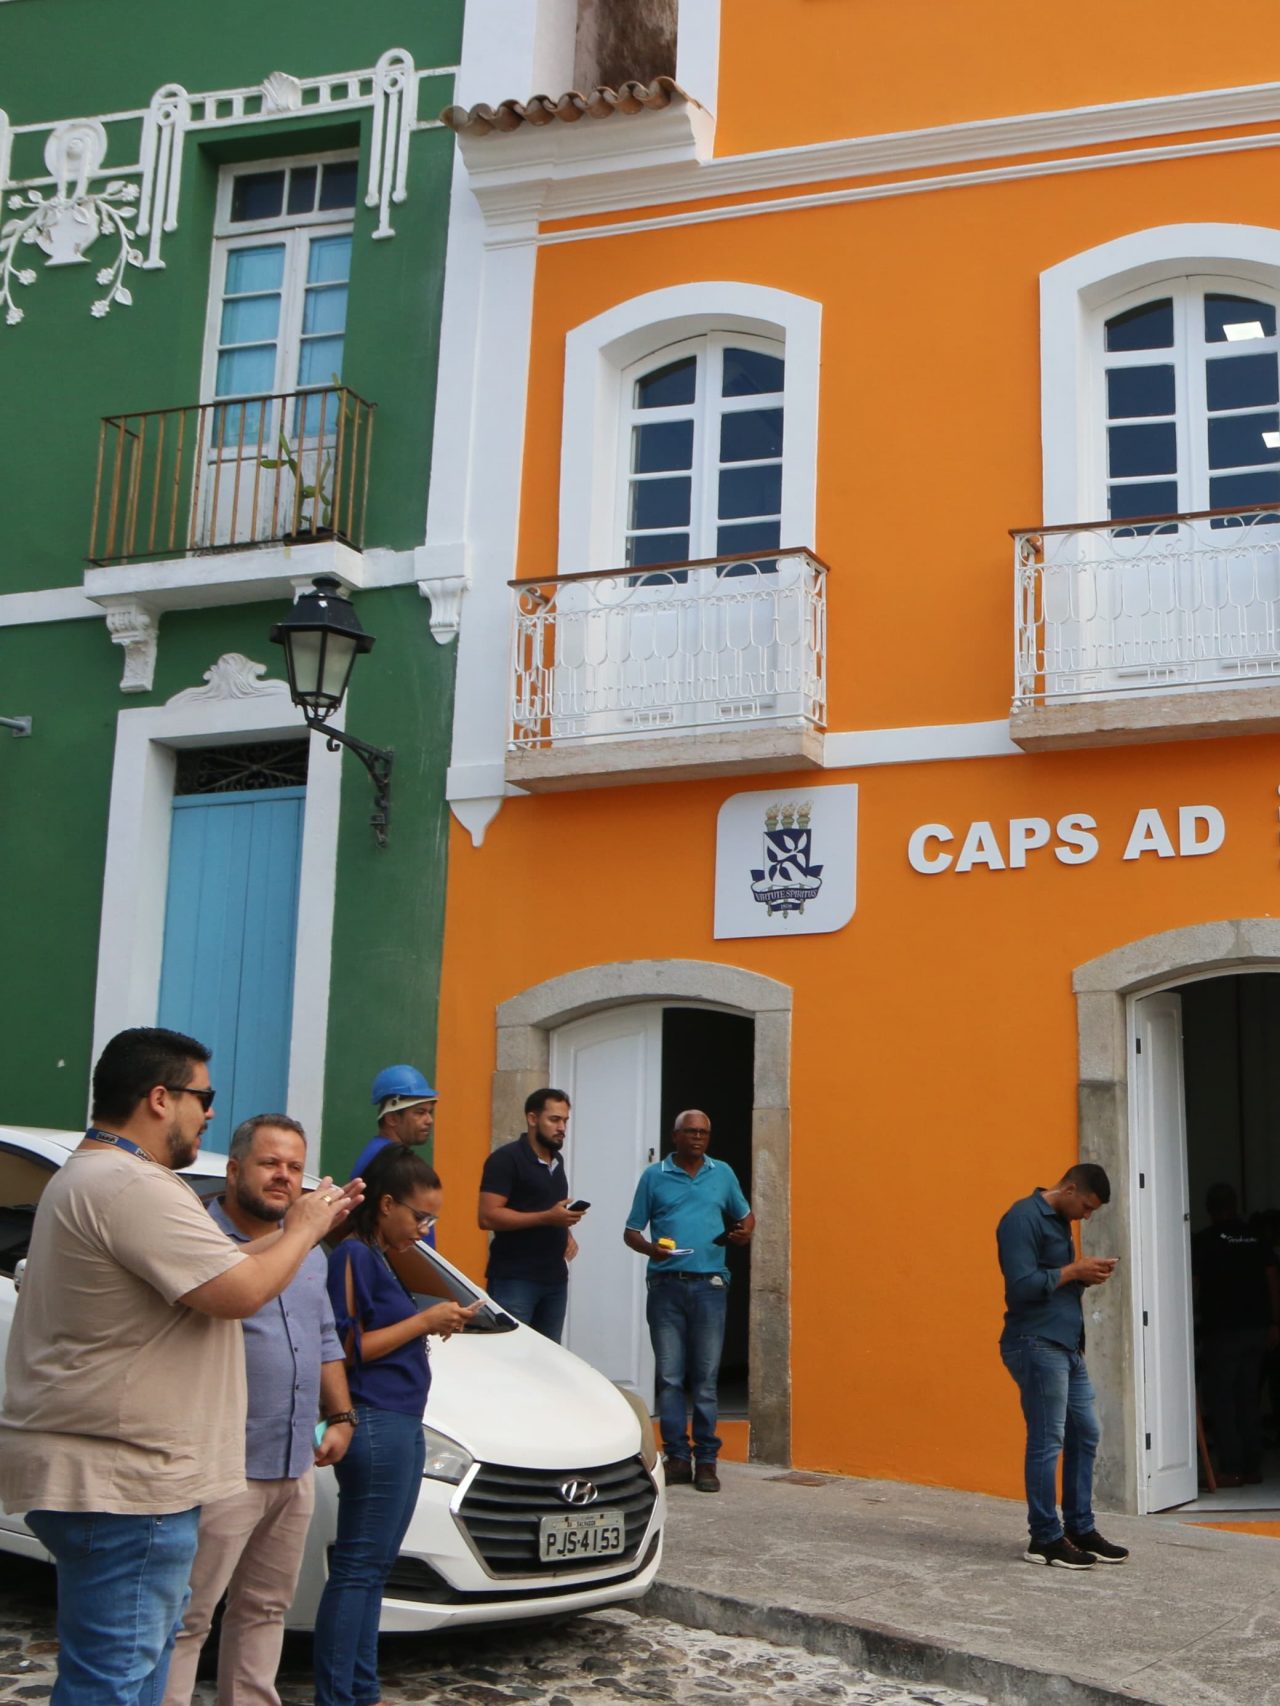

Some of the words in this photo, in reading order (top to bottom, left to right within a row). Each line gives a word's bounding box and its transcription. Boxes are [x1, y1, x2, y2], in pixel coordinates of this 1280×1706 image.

[908, 813, 1099, 874] CAPS
[1123, 805, 1225, 860] AD
[755, 890, 785, 901] VIRTUTE
